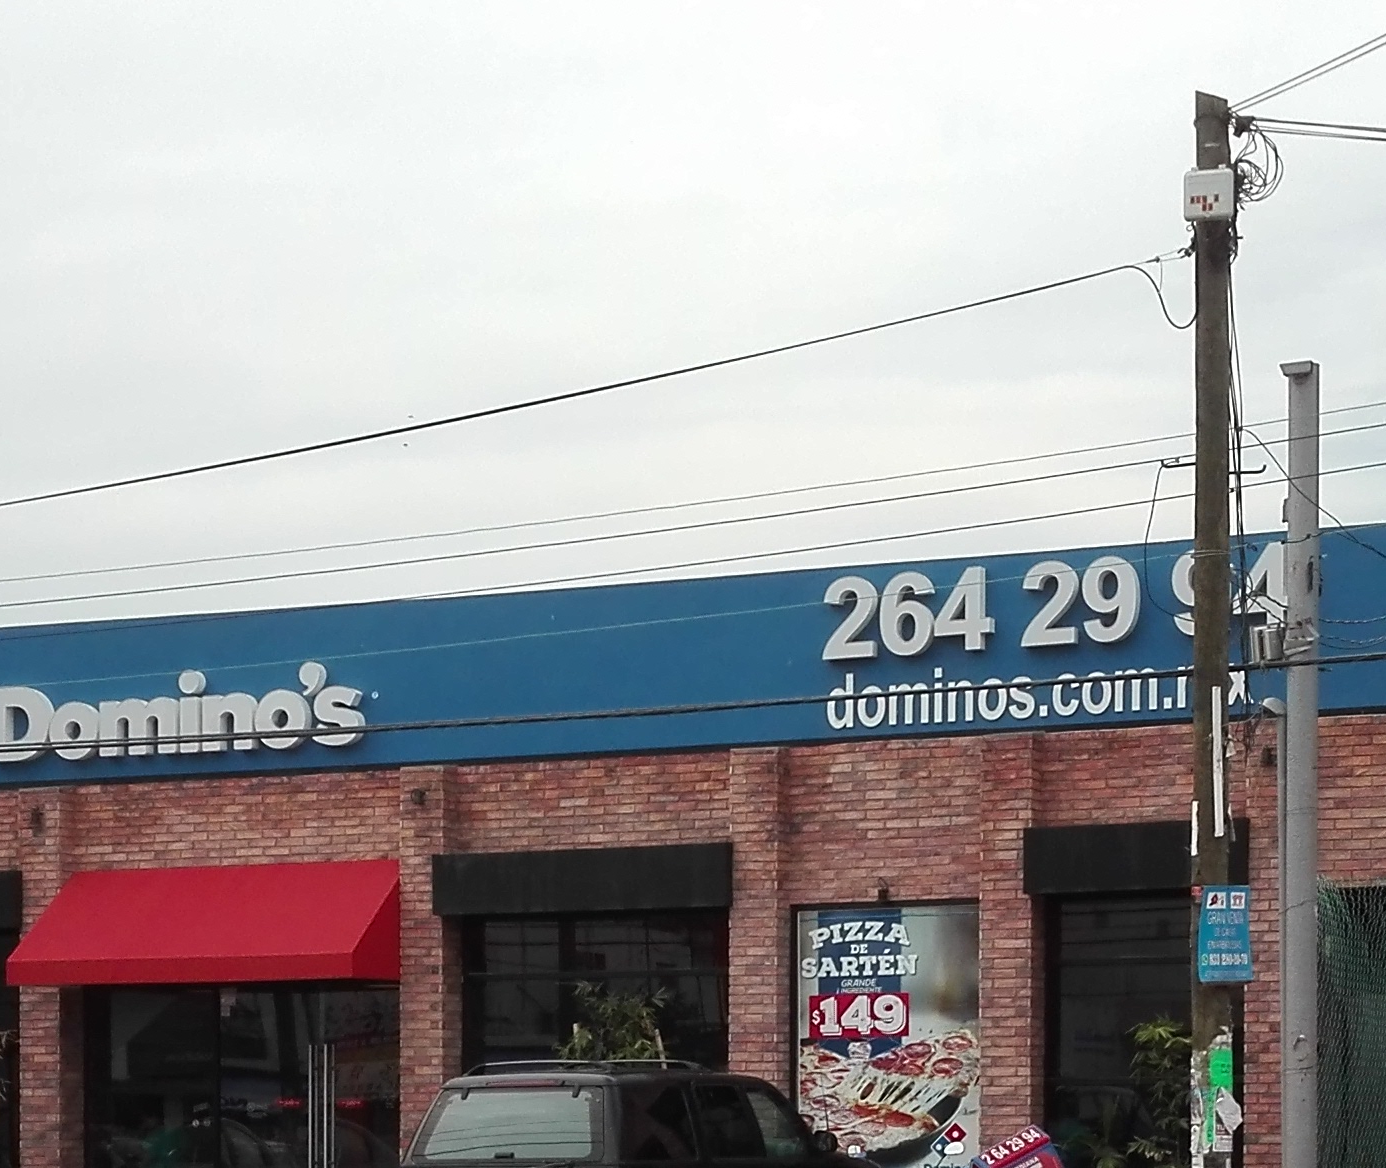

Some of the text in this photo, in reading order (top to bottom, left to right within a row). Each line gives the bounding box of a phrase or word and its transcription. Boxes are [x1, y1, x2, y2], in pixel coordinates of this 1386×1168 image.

[822, 566, 996, 661] 264
[1021, 556, 1142, 648] 29
[808, 921, 911, 950] PIZZA
[850, 943, 869, 955] DE
[801, 948, 918, 979] SARTÉN
[840, 978, 877, 988] GRANDE
[812, 994, 906, 1036] $149
[1005, 1136, 1026, 1153] 29
[1021, 1128, 1041, 1144] 94
